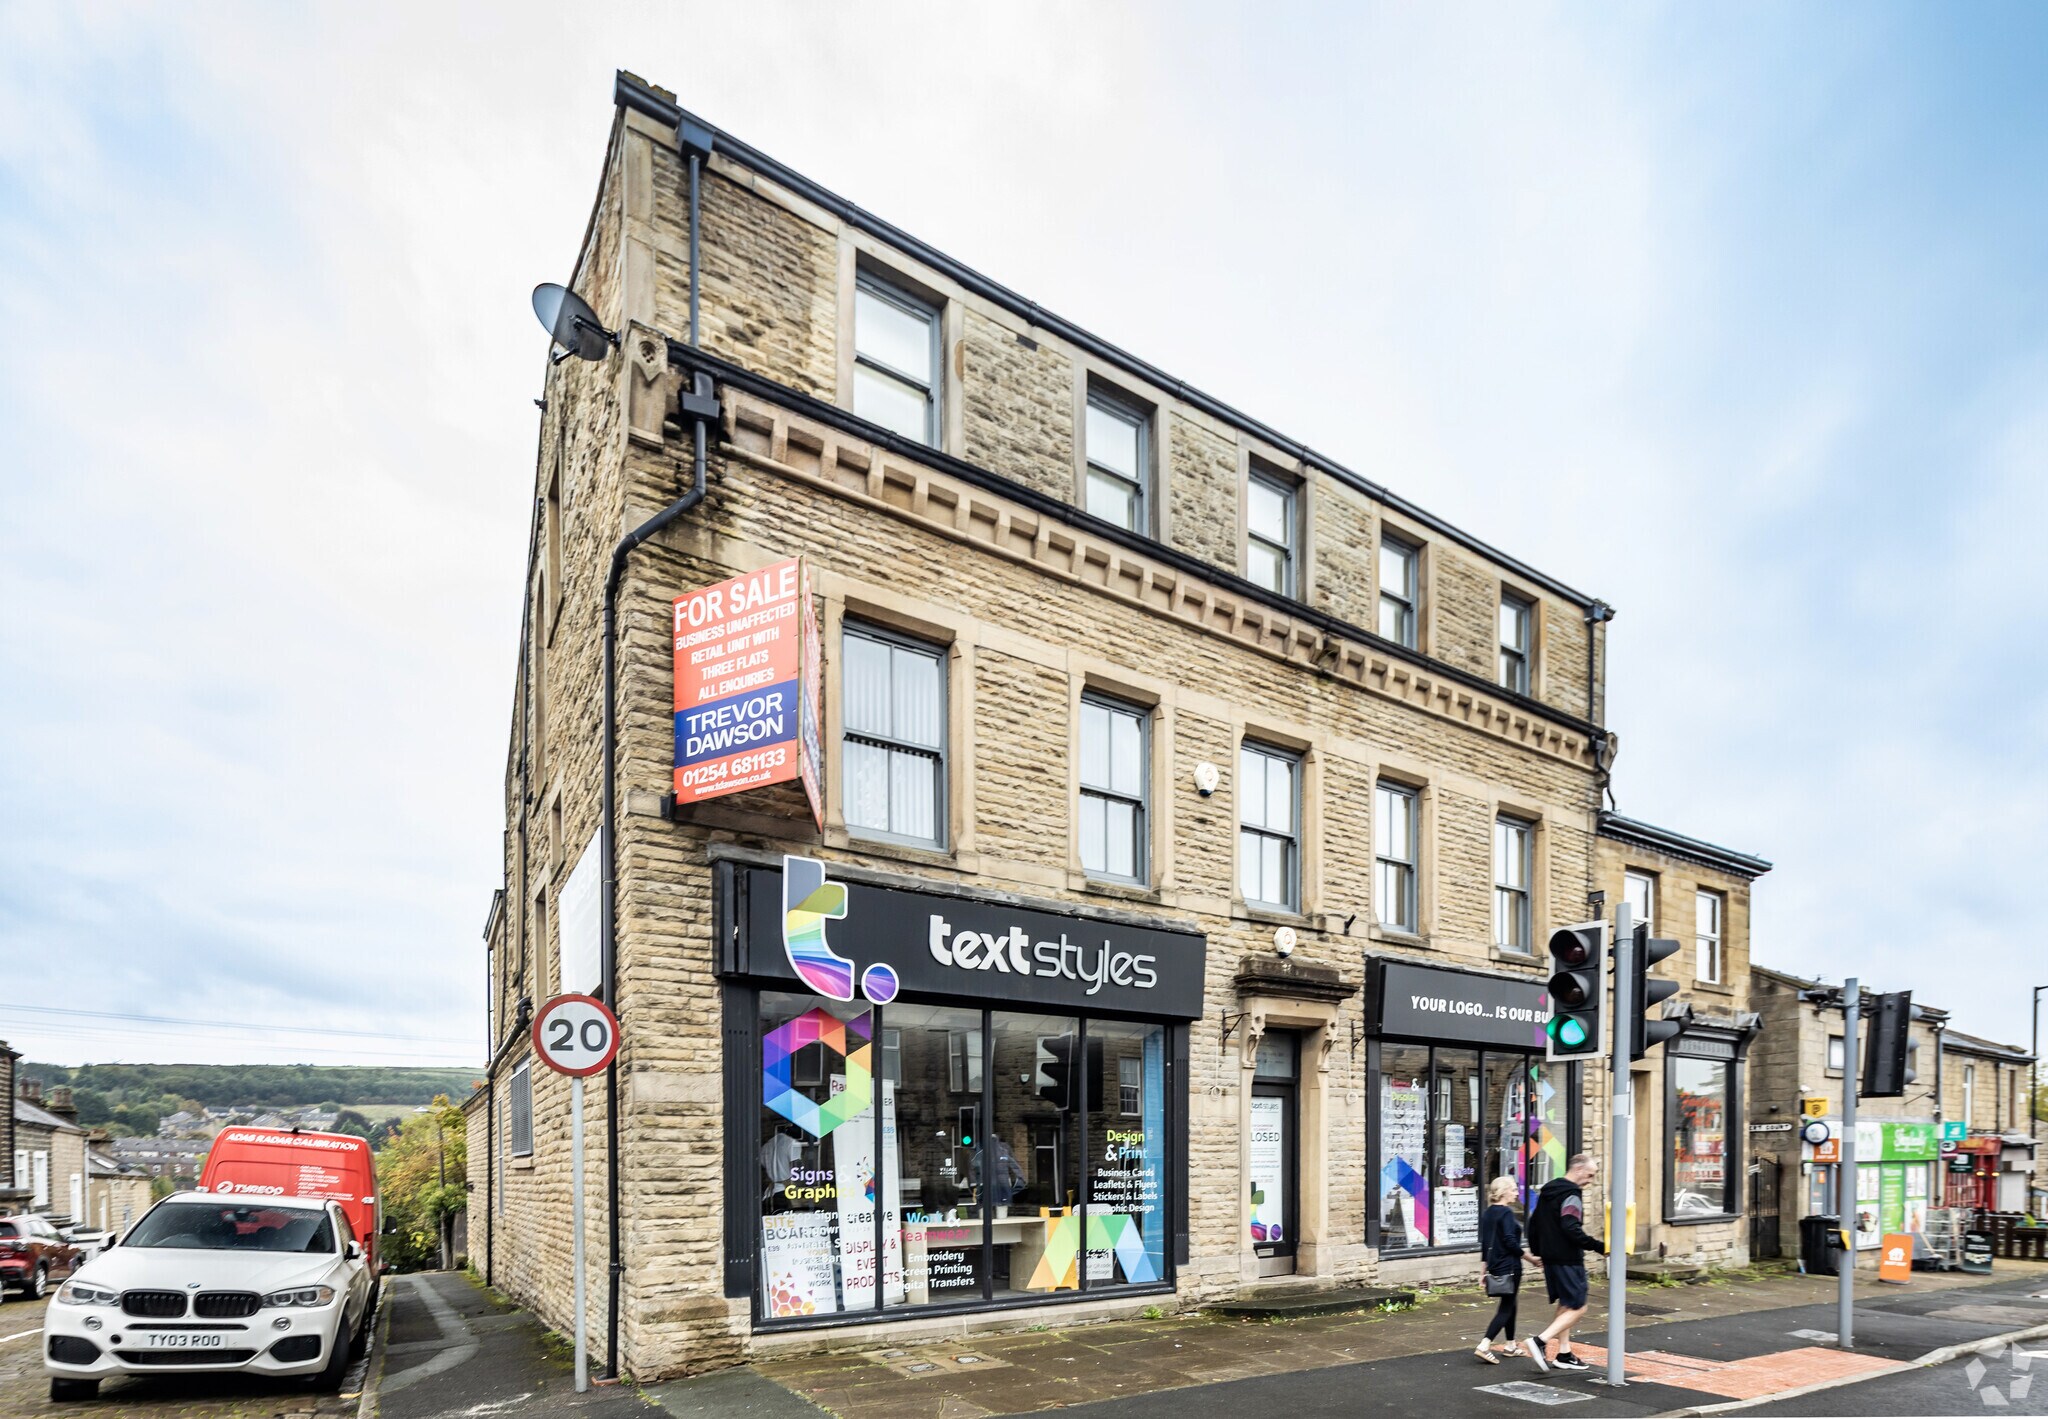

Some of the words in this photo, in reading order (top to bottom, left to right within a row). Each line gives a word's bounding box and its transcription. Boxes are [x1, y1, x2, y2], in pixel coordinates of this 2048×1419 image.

[675, 590, 724, 632] FOR
[730, 565, 796, 614] SALE
[675, 624, 725, 650] BUSINESS
[727, 601, 795, 635] UNAFFECTED
[691, 644, 726, 664] RETAIL
[727, 635, 751, 654] UNIT
[753, 627, 779, 646] WITH
[701, 659, 735, 680] THREE
[736, 649, 769, 671] FLATS
[698, 685, 718, 701] ALL
[719, 667, 775, 695] ENQUIRIES
[686, 692, 783, 735] TREVOR
[686, 714, 784, 758] DAWSON
[682, 762, 728, 788] 01254
[731, 748, 786, 776] 681133
[1411, 995, 1447, 1013] YOUR
[1449, 1000, 1494, 1018] LOGO...
[1495, 1006, 1507, 1019] IS
[1509, 1007, 1533, 1022] OUR
[1534, 1010, 1549, 1024] BU
[548, 1018, 608, 1052] 20
[225, 1132, 256, 1142] ADAS
[256, 1135, 292, 1145] RADAR
[293, 1137, 360, 1151] CALIBRATION
[1106, 1129, 1145, 1145] Design
[1250, 1132, 1280, 1142] LOSED
[1104, 1144, 1118, 1161] &
[1118, 1146, 1148, 1159] Print
[790, 1166, 834, 1185] Signs
[1097, 1167, 1131, 1178] Business
[1132, 1167, 1155, 1177] Cards
[1093, 1180, 1126, 1189] Leaflets
[1126, 1180, 1133, 1189] &
[1134, 1180, 1157, 1191] Flyers
[1093, 1192, 1125, 1201] Stickers
[1125, 1192, 1132, 1200] &
[1133, 1192, 1158, 1200] Labels
[1128, 1203, 1155, 1213] Design
[764, 1216, 795, 1228] SITE
[906, 1210, 943, 1224] Work
[946, 1208, 960, 1227] &
[897, 1228, 971, 1242] Teamwear
[890, 1238, 896, 1250] &
[857, 1256, 889, 1271] EVET
[908, 1250, 964, 1263] Embroidery
[900, 1267, 932, 1277] Screen
[934, 1263, 973, 1275] Printing
[846, 1271, 900, 1290] PRODCTS
[929, 1276, 975, 1288] Transfers
[148, 1334, 188, 1347] TY03
